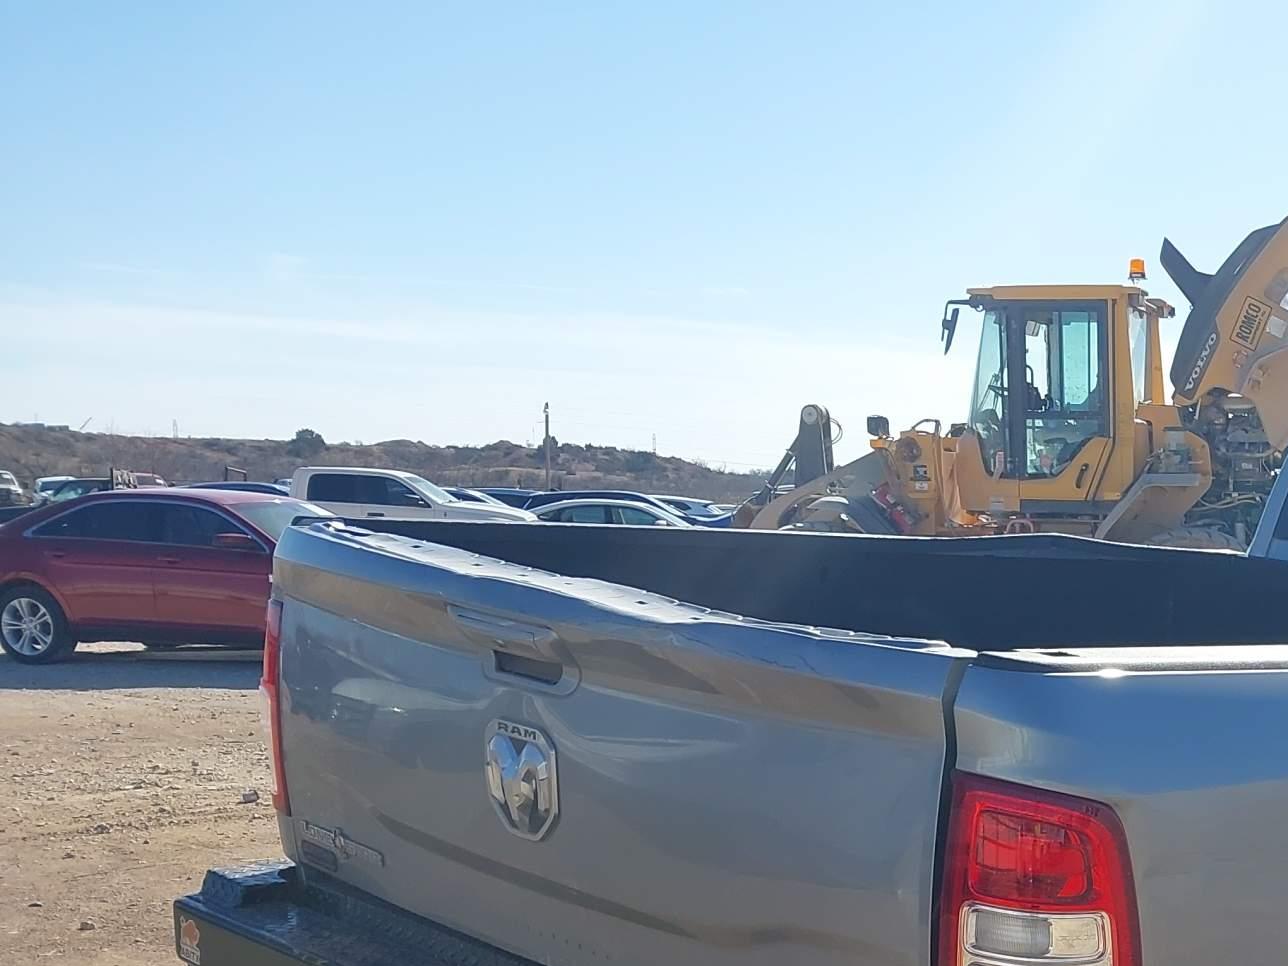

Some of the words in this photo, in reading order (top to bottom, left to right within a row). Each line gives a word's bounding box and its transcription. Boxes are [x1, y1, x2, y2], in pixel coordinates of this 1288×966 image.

[1236, 303, 1261, 343] ROMCO
[1184, 333, 1217, 391] VOLVO
[497, 722, 537, 741] RAM
